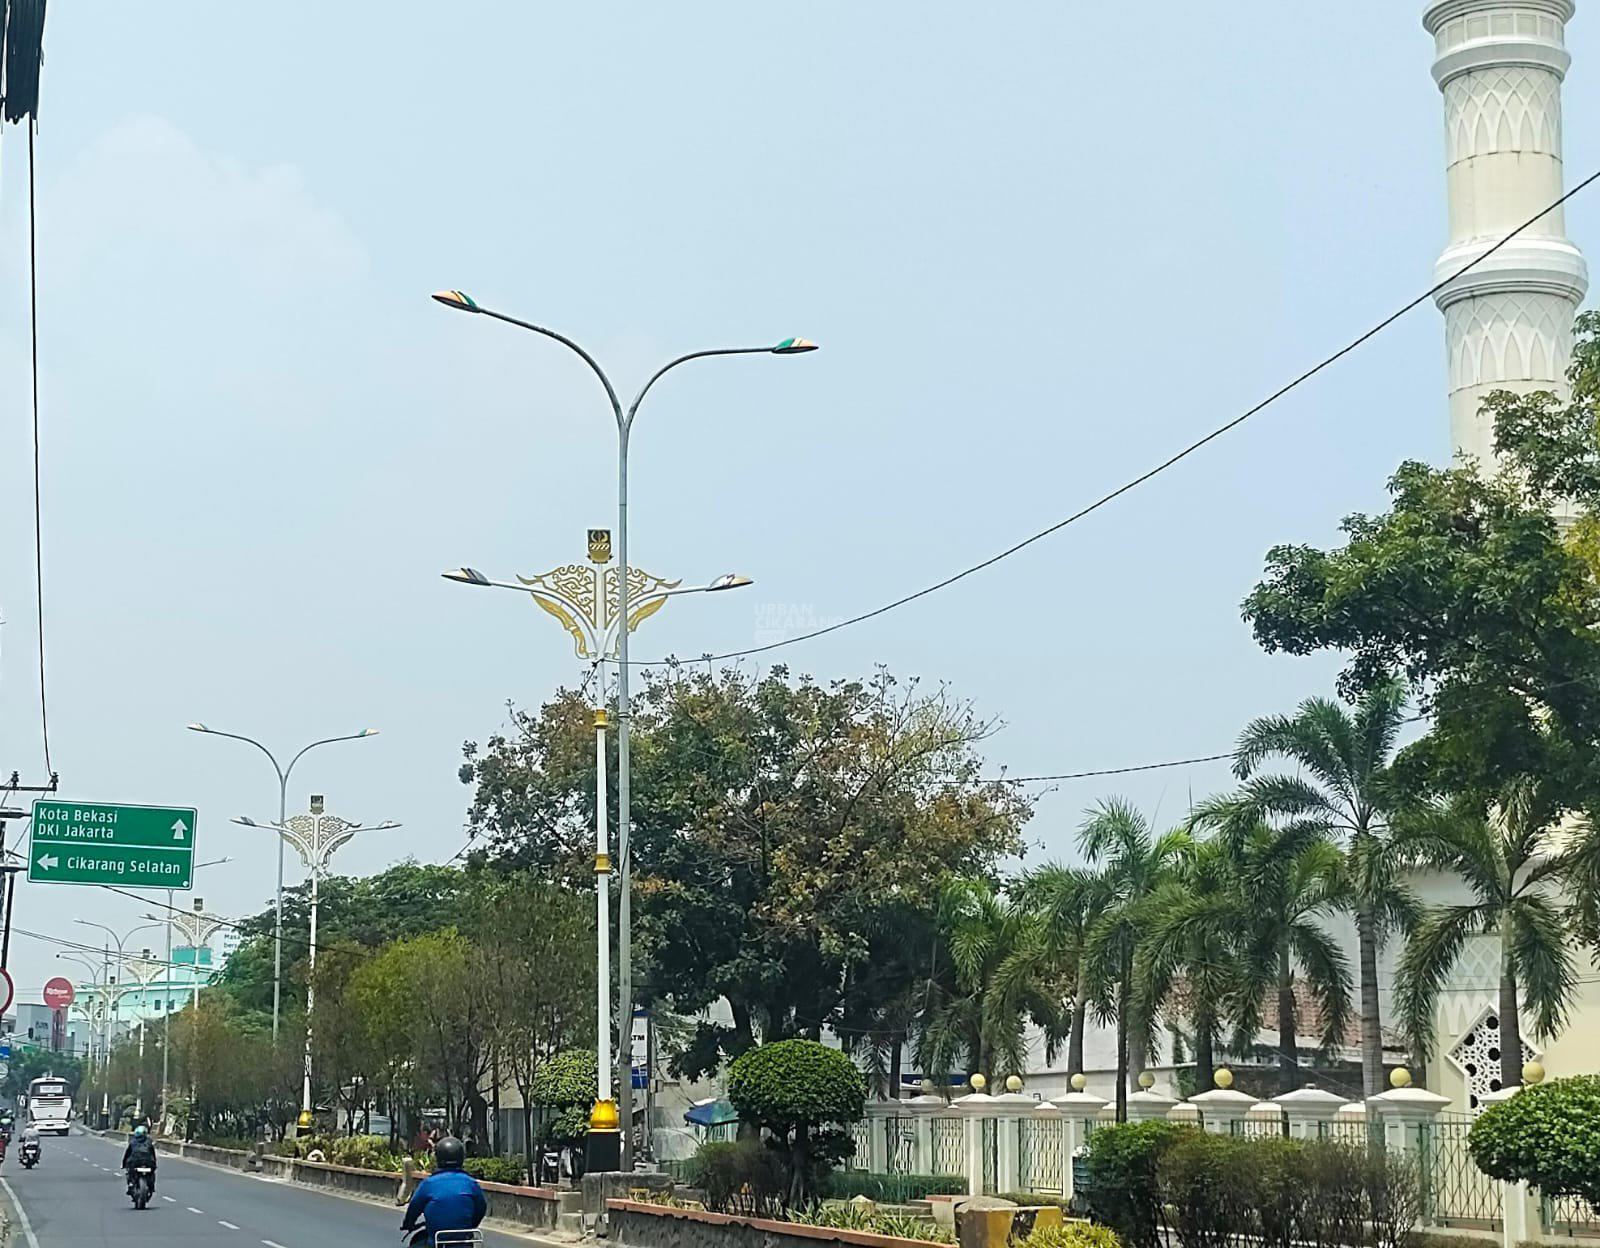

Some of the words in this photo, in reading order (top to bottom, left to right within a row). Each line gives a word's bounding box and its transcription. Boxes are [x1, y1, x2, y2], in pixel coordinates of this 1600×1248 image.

[39, 807, 69, 821] Kota
[74, 809, 118, 824] Bekasi
[38, 823, 59, 836] DKI
[64, 824, 114, 839] Jakarta
[67, 856, 125, 875] Cikarang
[129, 860, 181, 874] Selatan
